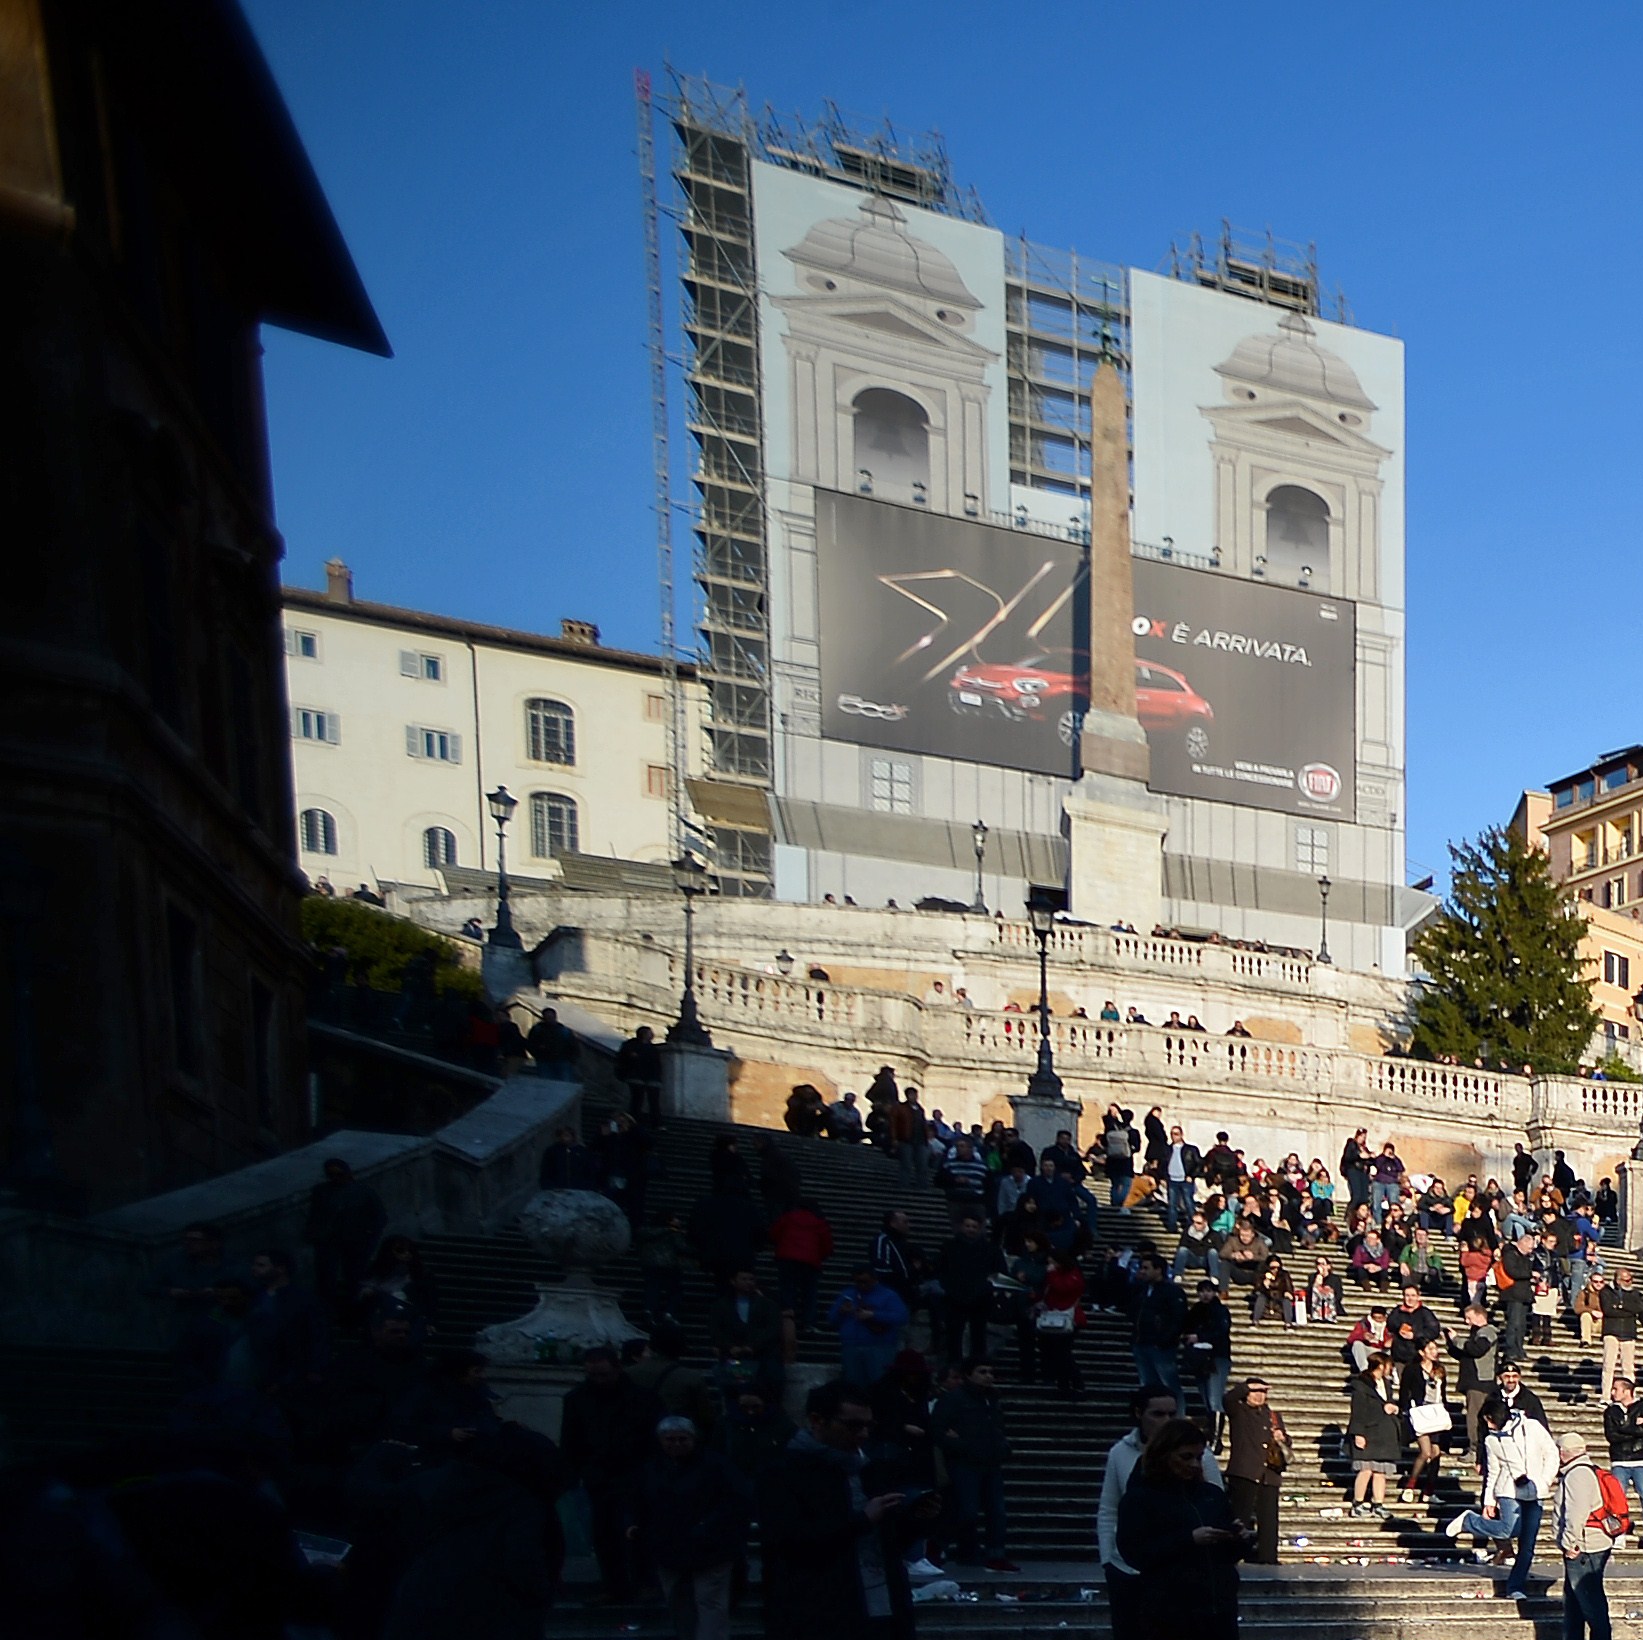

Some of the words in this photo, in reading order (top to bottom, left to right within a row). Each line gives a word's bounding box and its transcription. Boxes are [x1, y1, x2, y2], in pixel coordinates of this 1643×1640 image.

[1131, 616, 1167, 639] 0X
[1171, 621, 1190, 645] È
[1193, 628, 1313, 667] ARRIVATA.
